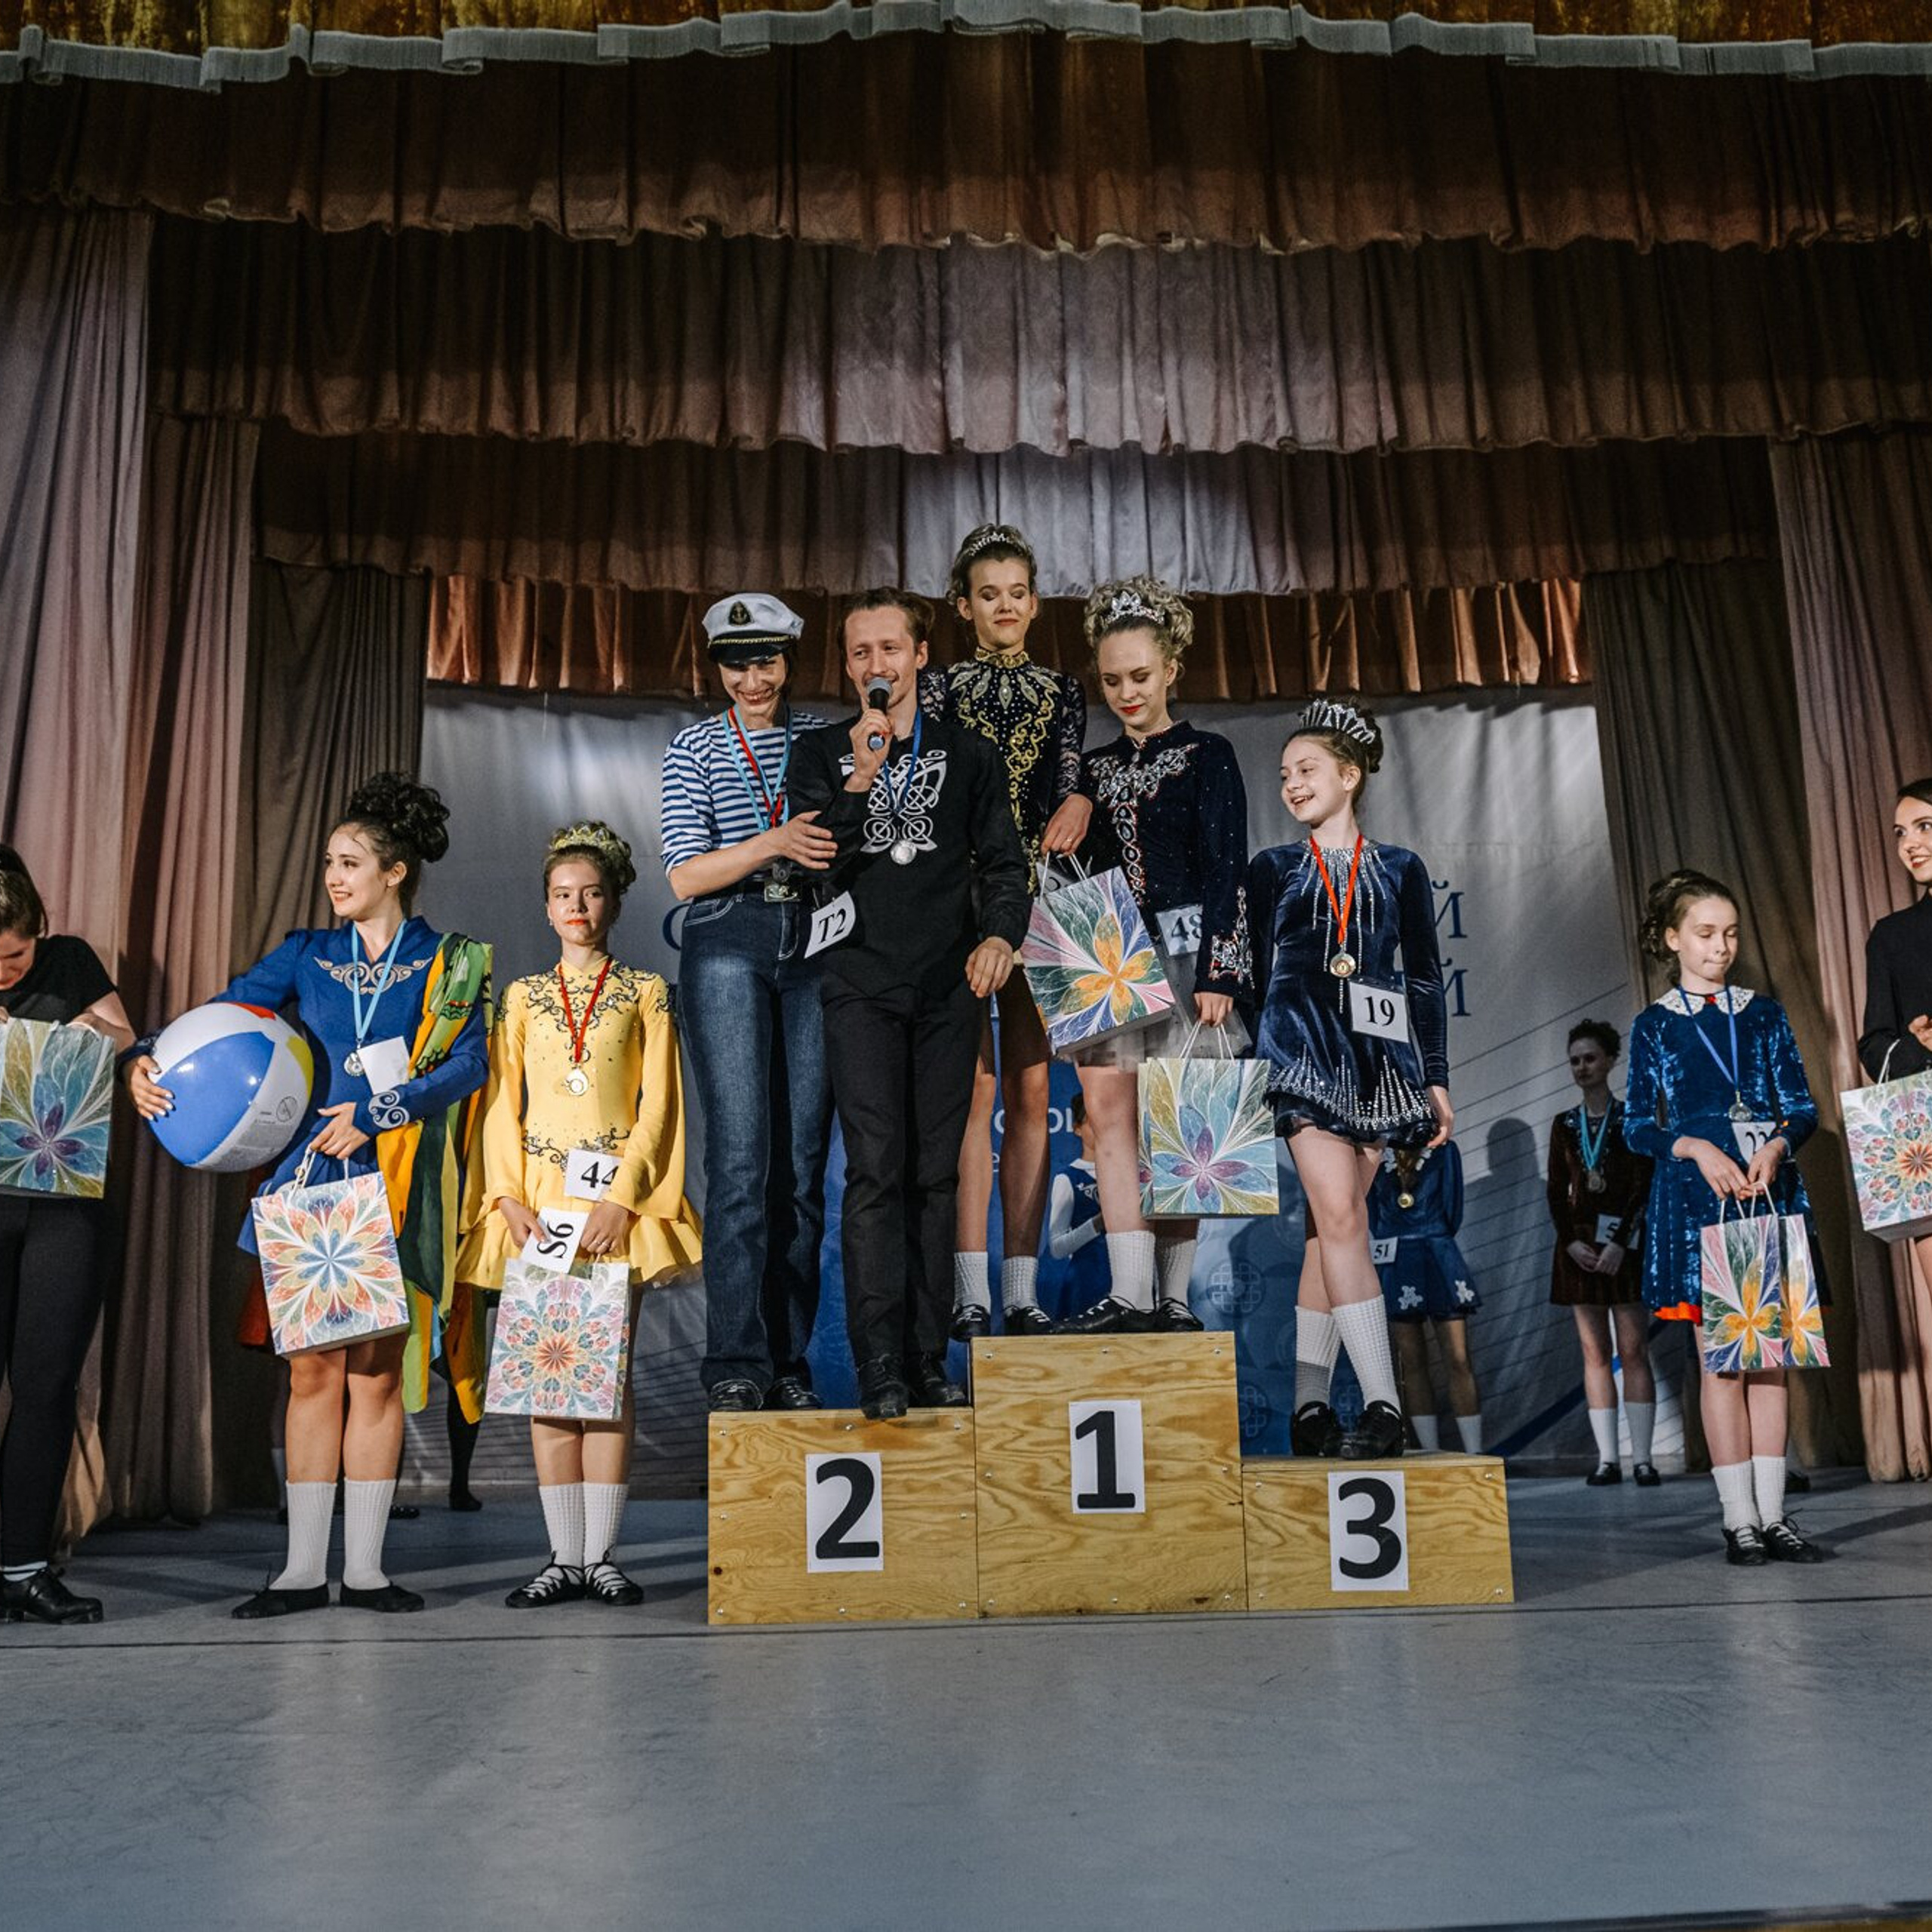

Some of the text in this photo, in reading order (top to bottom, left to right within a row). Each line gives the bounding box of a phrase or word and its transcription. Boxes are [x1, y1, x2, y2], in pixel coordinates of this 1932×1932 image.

[817, 908, 847, 945] T2
[1171, 913, 1203, 942] 48
[1364, 995, 1395, 1026] 19
[1374, 1243, 1390, 1260] 51
[1075, 1410, 1136, 1509] 1
[815, 1457, 881, 1560] 2
[1337, 1477, 1402, 1580] 3
